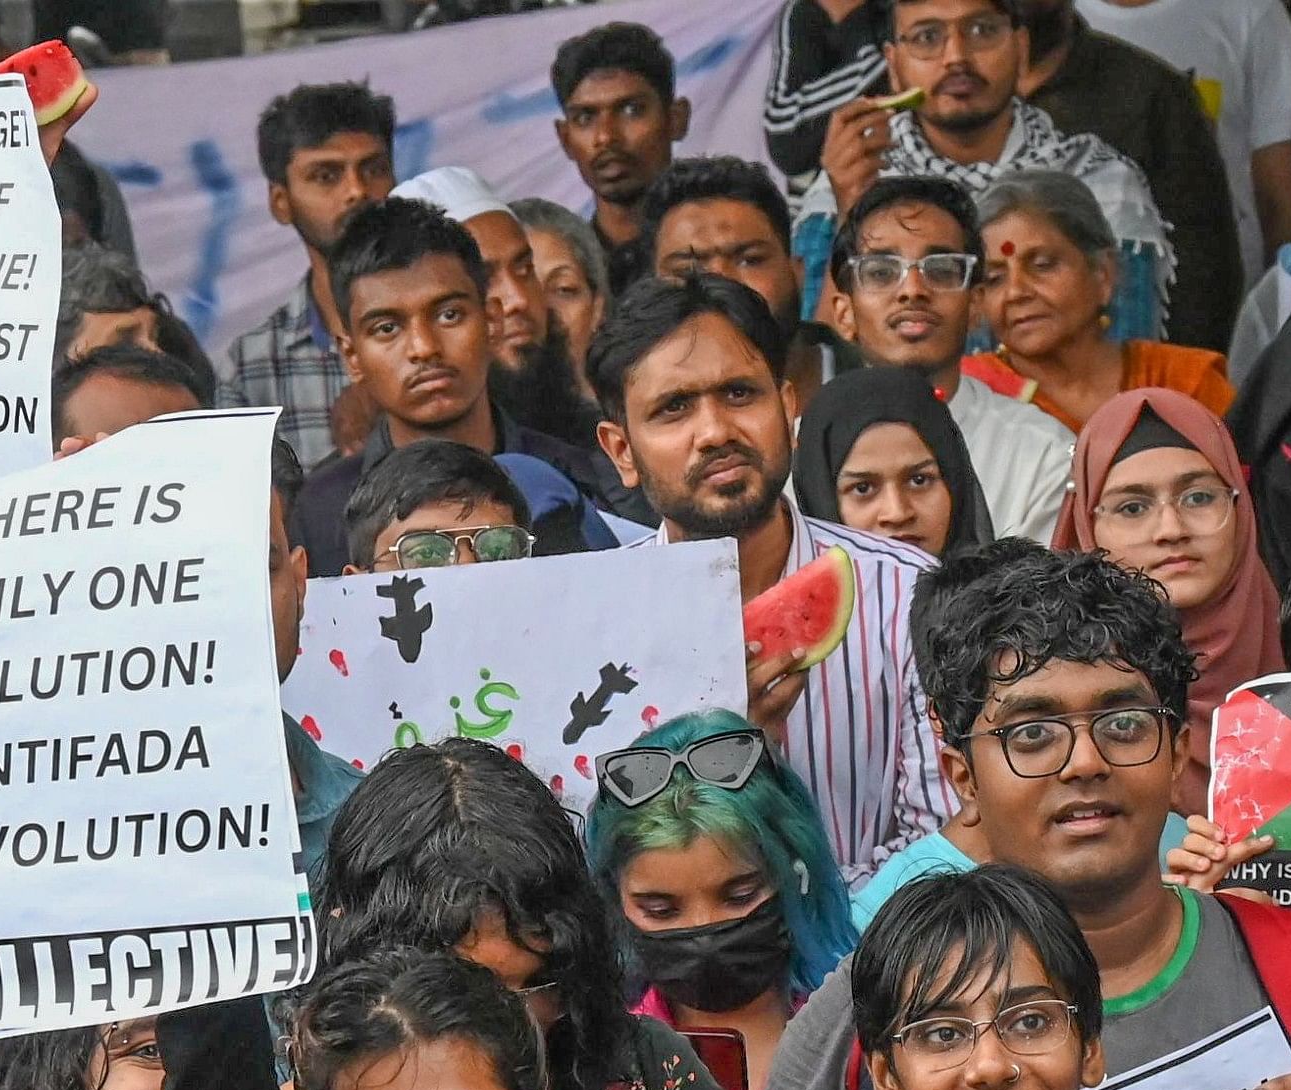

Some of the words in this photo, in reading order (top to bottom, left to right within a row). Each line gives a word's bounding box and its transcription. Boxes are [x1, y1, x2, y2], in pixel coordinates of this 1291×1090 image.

[132, 482, 187, 527] IS
[88, 557, 206, 611] ONE
[1224, 862, 1272, 880] WHY
